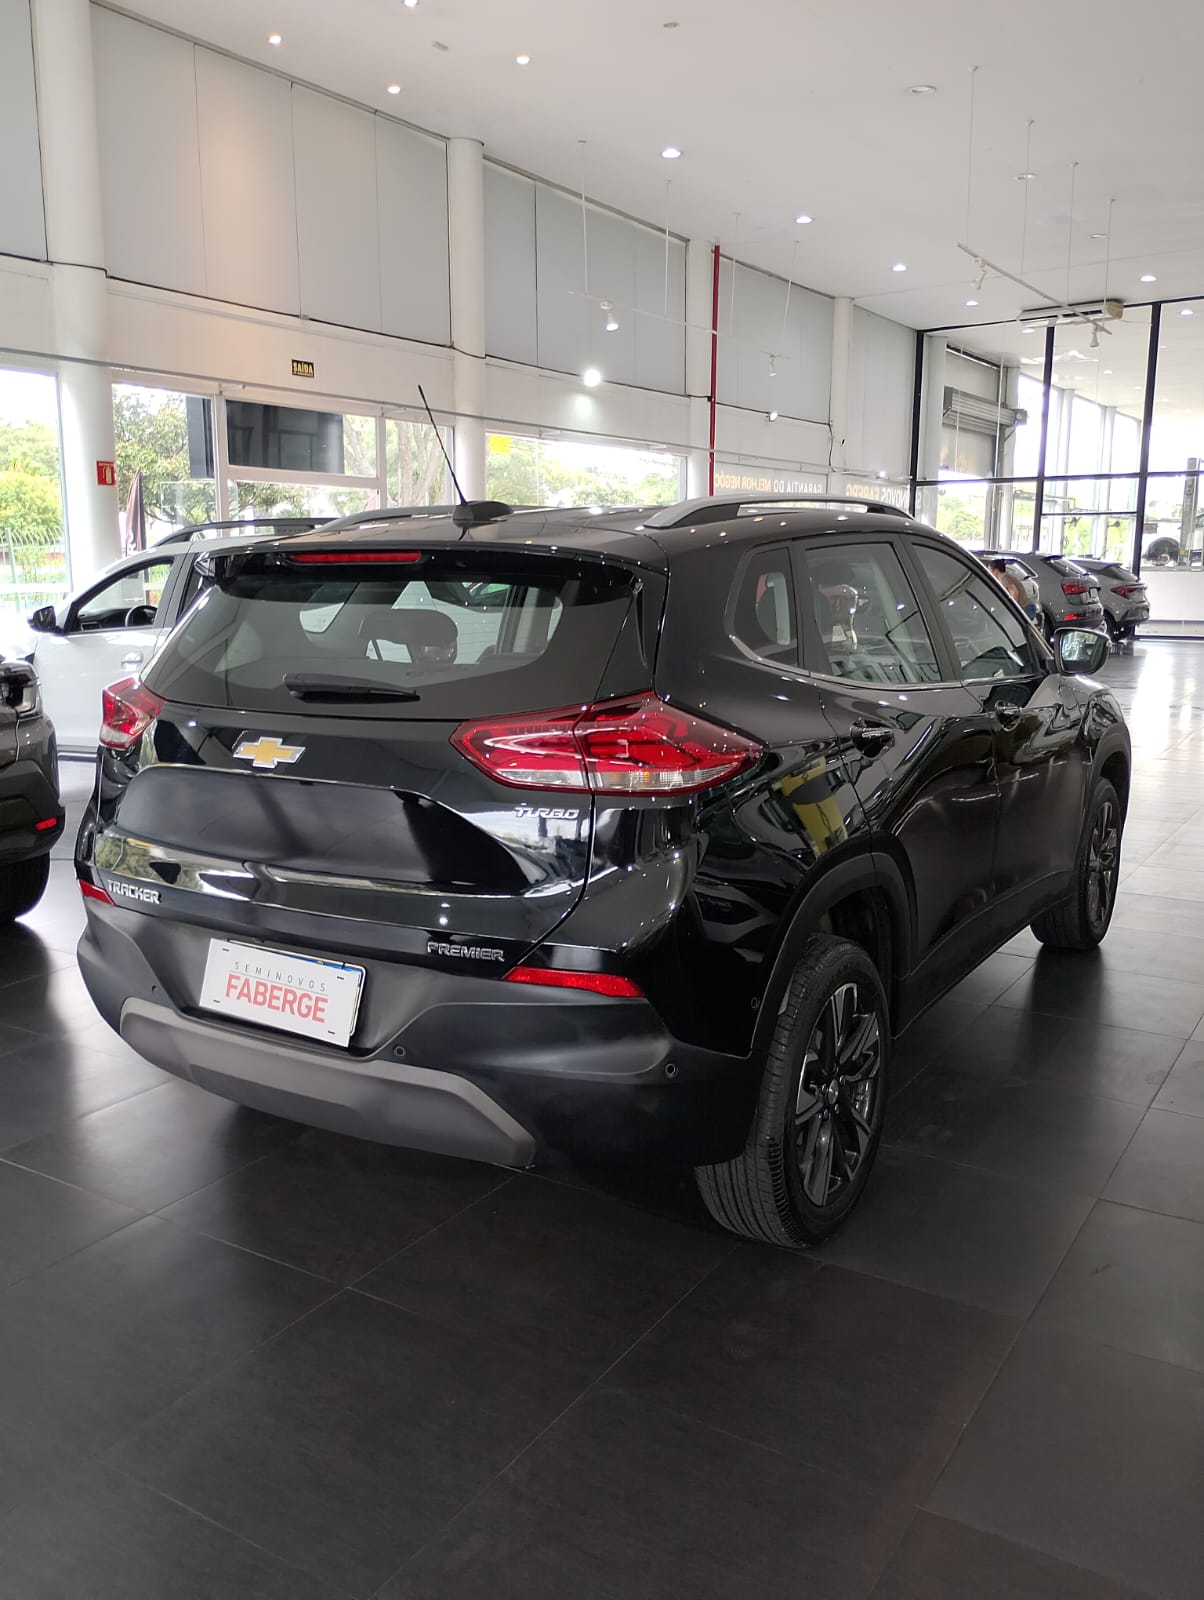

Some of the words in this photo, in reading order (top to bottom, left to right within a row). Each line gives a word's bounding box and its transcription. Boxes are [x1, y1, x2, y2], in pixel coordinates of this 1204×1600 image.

[293, 361, 313, 374] SAÍDA
[514, 806, 580, 819] TURBO
[107, 879, 161, 905] TRACKER
[427, 941, 505, 962] PREMIER
[234, 961, 327, 992] SEMINOVOS
[225, 973, 329, 1023] FABERGE
